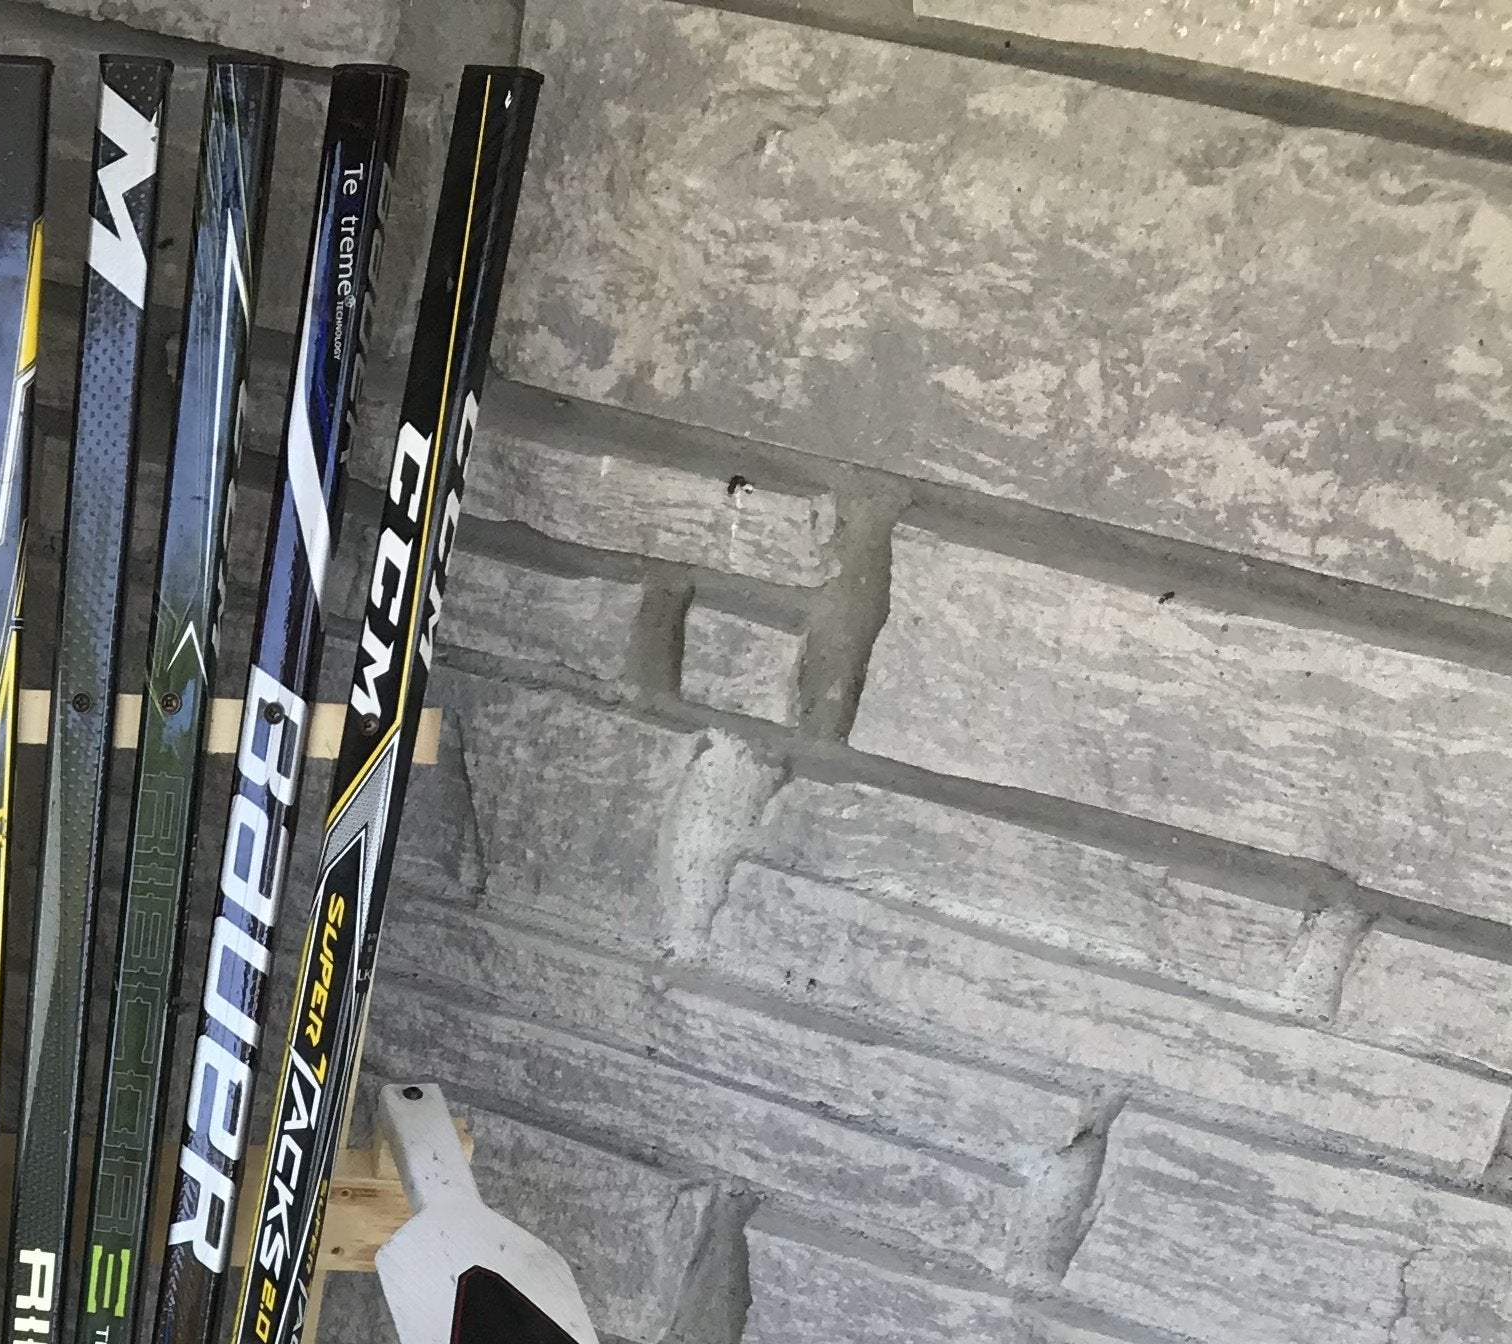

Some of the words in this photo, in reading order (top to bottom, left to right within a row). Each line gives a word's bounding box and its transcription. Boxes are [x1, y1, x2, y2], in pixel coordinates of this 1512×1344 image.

[350, 419, 434, 720] CCM
[304, 891, 346, 1049] SUPER
[262, 1043, 331, 1283] TACKS
[255, 1275, 280, 1344] 2.0
